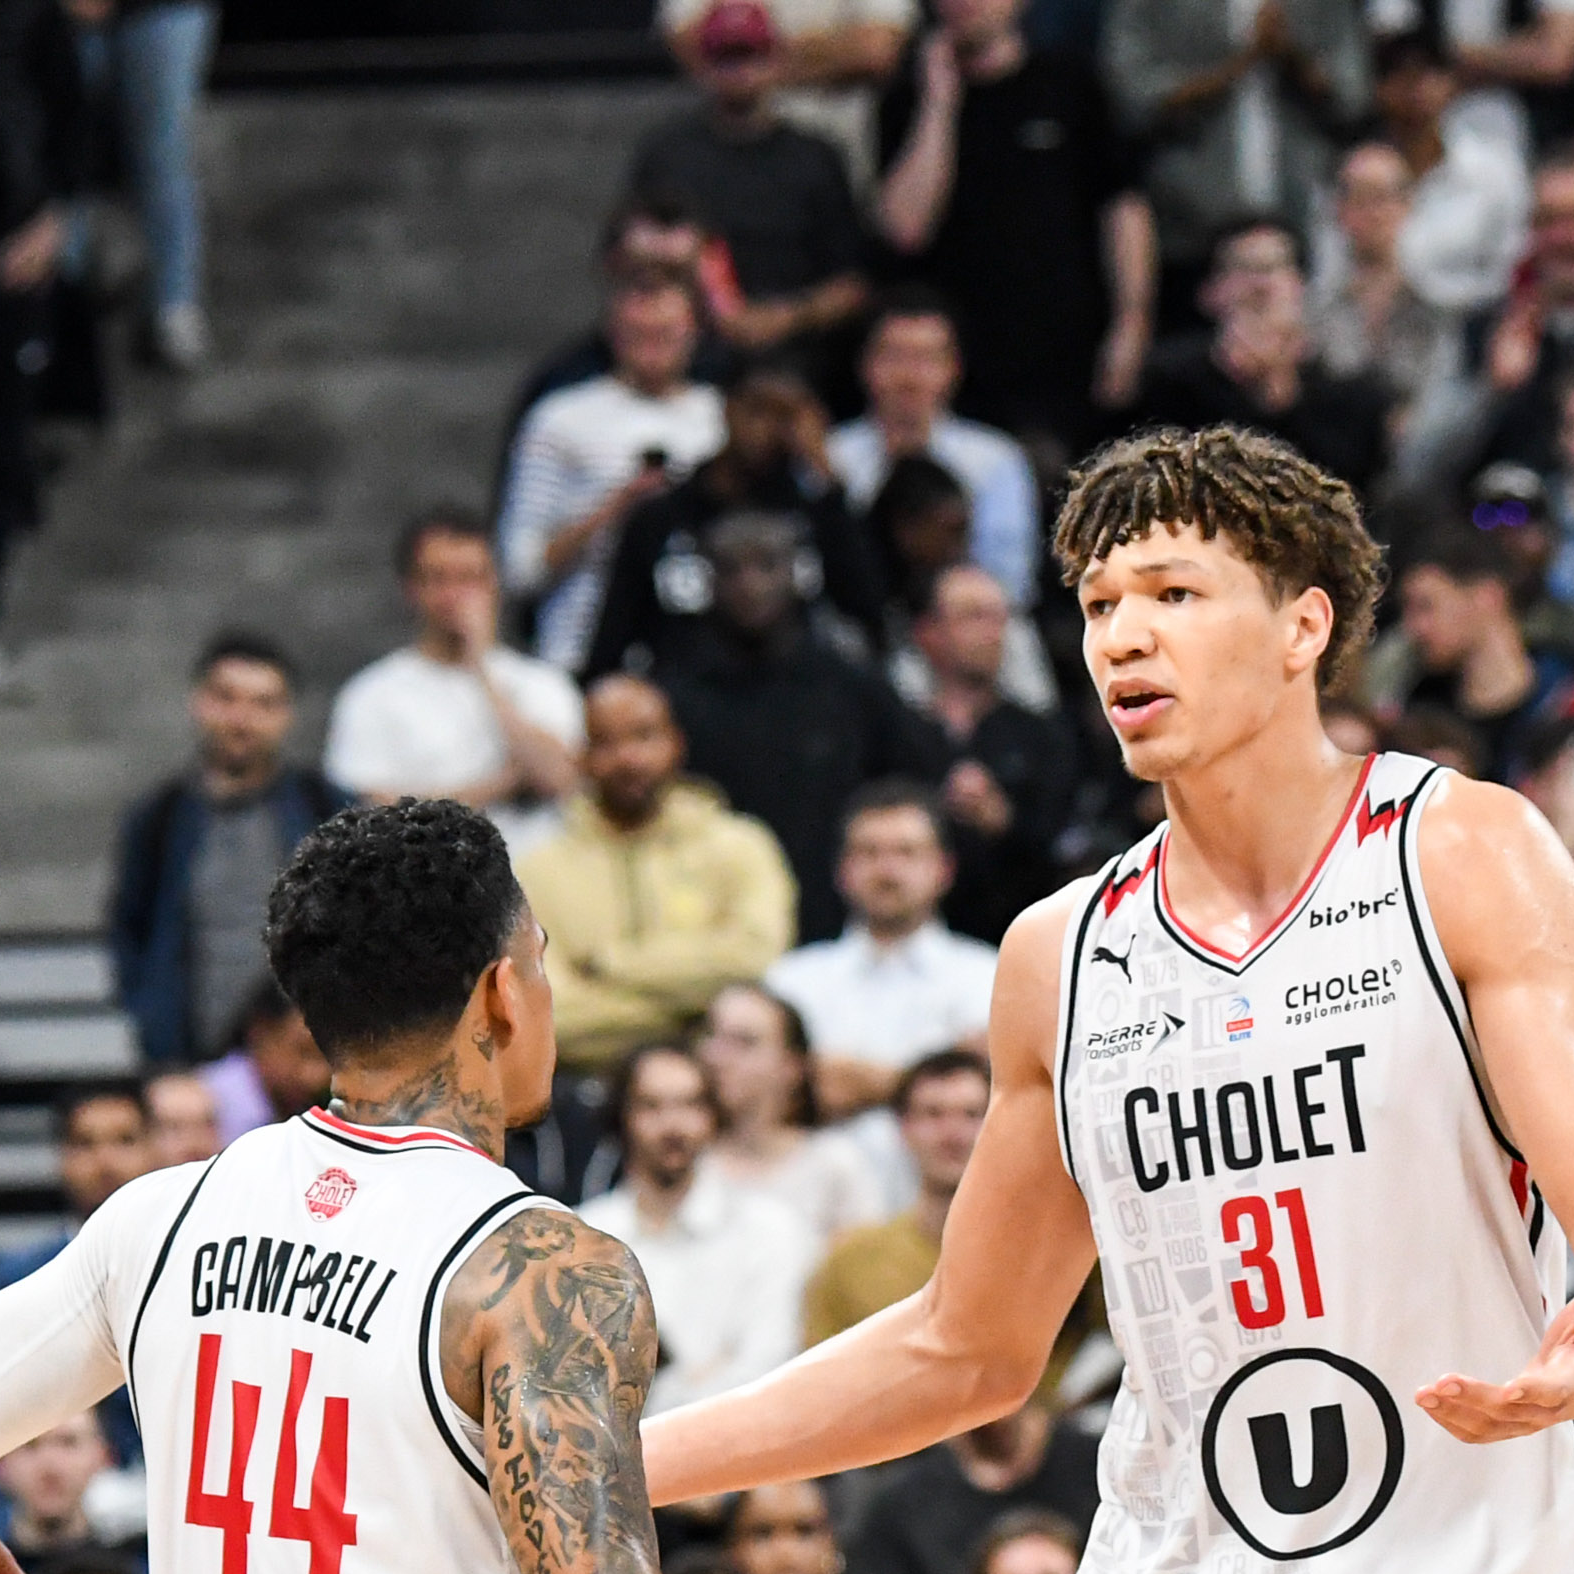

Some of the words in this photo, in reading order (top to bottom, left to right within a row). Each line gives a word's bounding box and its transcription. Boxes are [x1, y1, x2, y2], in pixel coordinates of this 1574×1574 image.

[1084, 1039, 1144, 1061] ransports
[1285, 991, 1397, 1026] agglomération
[1123, 1044, 1367, 1194] CHOLET
[305, 1181, 358, 1207] CHOLET
[191, 1235, 398, 1344] CAMPBELL
[1219, 1187, 1325, 1331] 31
[1246, 1403, 1349, 1515] U
